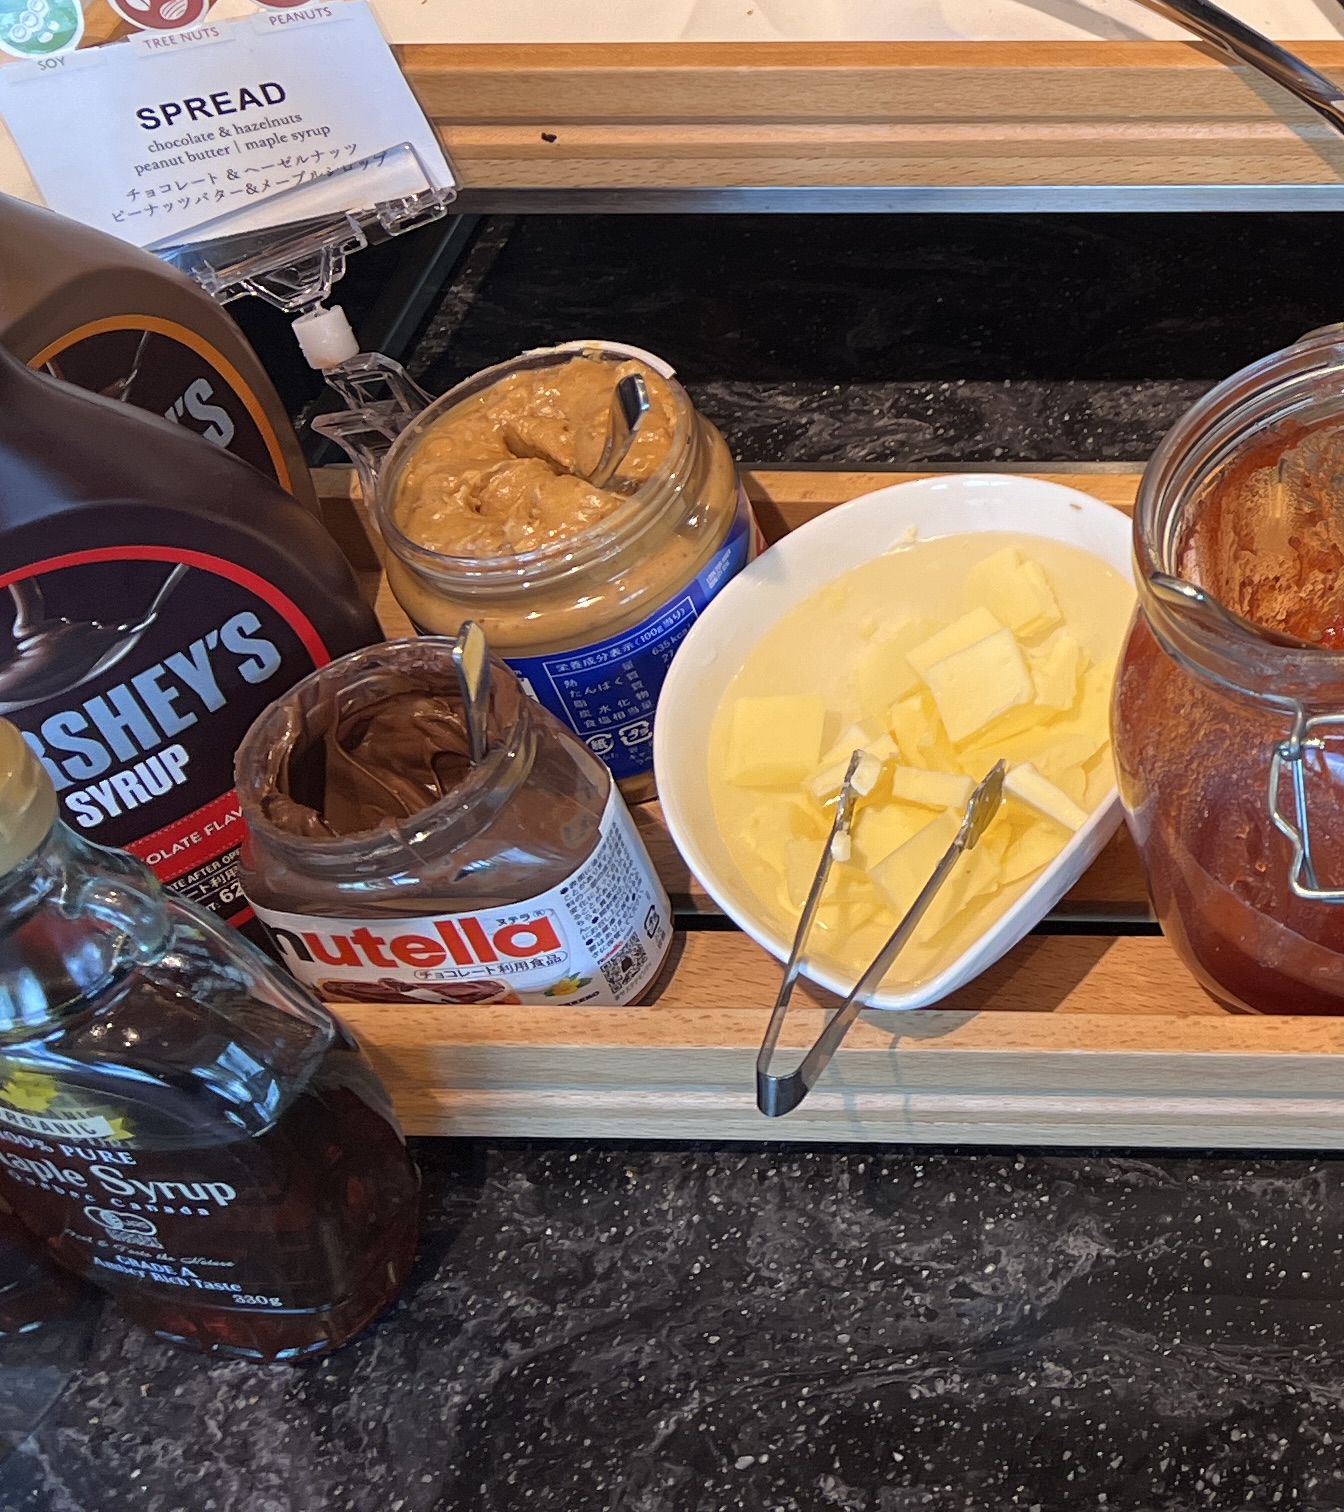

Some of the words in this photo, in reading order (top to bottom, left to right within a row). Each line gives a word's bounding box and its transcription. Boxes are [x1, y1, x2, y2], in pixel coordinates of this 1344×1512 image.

[268, 6, 333, 26] PEANUTS
[143, 34, 178, 50] TREE
[181, 26, 220, 42] NUTS
[37, 55, 67, 72] SOY
[136, 81, 287, 130] SPREAD
[147, 131, 215, 153] chocolate
[218, 125, 233, 138] &
[235, 113, 303, 135] hazelnuts
[134, 154, 185, 177] peanut
[184, 144, 231, 163] butter
[245, 132, 289, 151] maple
[290, 125, 331, 143] syrup
[126, 172, 218, 202] チョコレート
[244, 143, 357, 173] ヘーゼルナッツ
[65, 744, 189, 828] SYRUP
[146, 831, 202, 865] OLATE
[203, 805, 243, 836] FLAV
[187, 861, 222, 884] AFTER
[270, 916, 562, 968] nutella
[419, 953, 563, 980] チョコレート利用食品
[5, 1110, 97, 1135] RGANIC
[58, 1143, 137, 1165] PURE
[0, 1152, 88, 1188] aple
[89, 1165, 237, 1206] Syrup
[111, 1197, 210, 1217] Canada
[115, 1254, 177, 1276] GRADE
[181, 1266, 199, 1279] A
[190, 1278, 242, 1292] Taste
